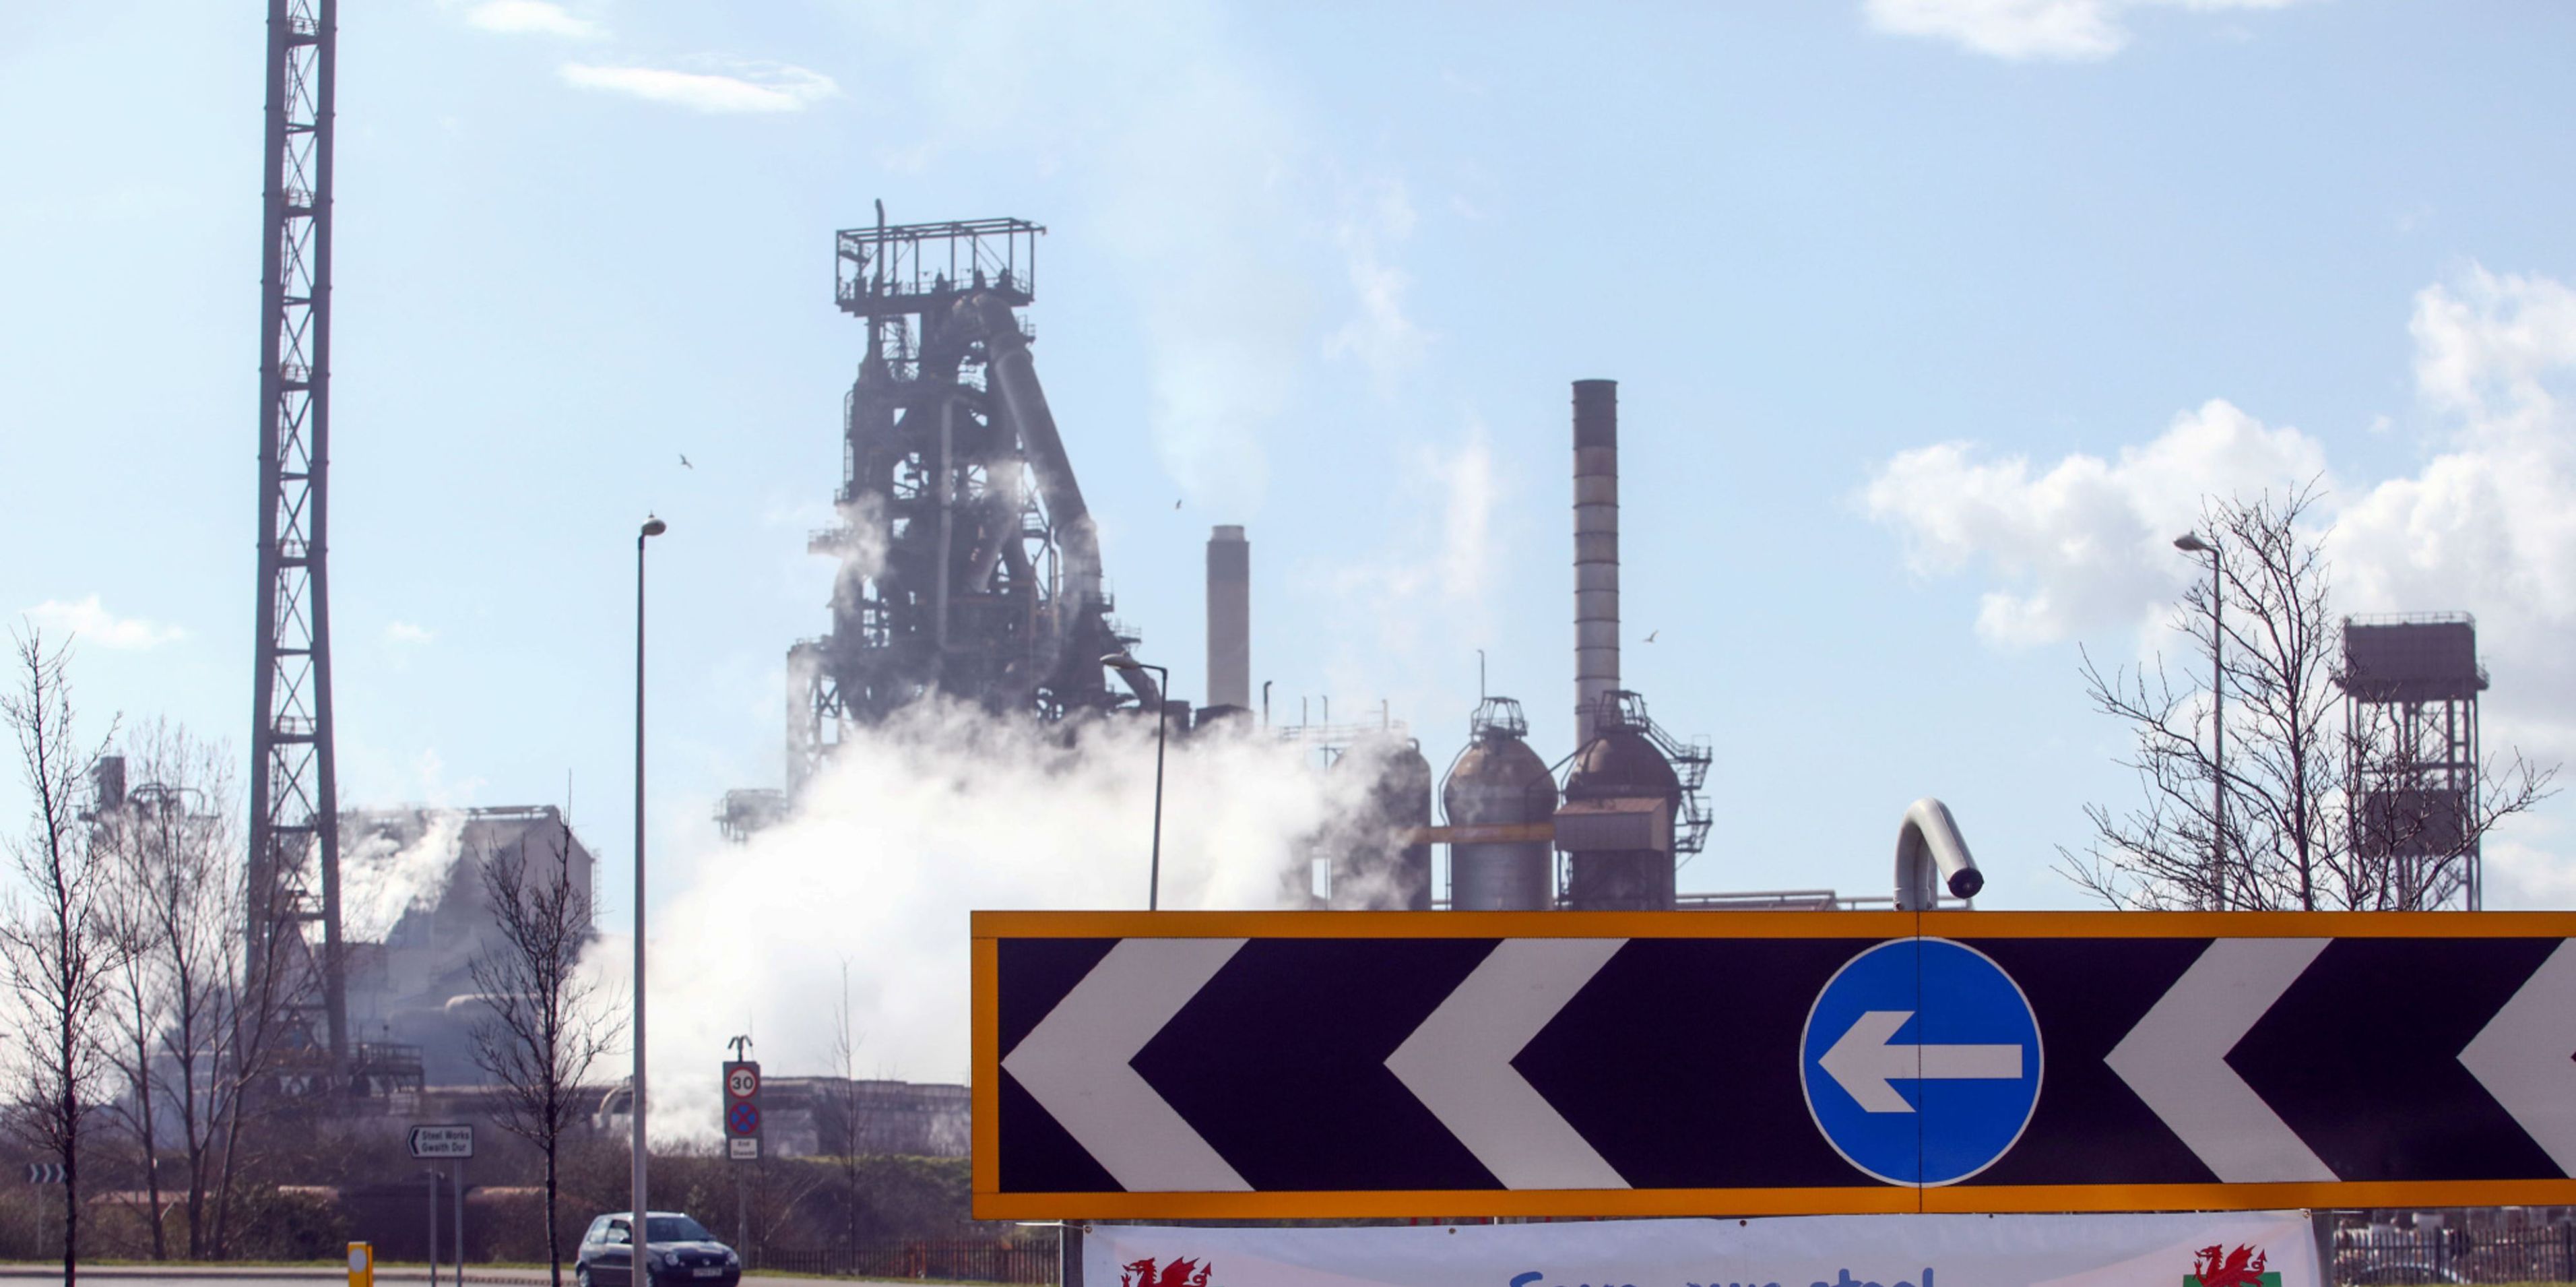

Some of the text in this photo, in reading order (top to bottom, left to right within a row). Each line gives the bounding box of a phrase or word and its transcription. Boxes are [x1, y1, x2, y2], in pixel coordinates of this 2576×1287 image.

[732, 1076, 754, 1090] 30
[422, 1131, 470, 1141] Steel Works
